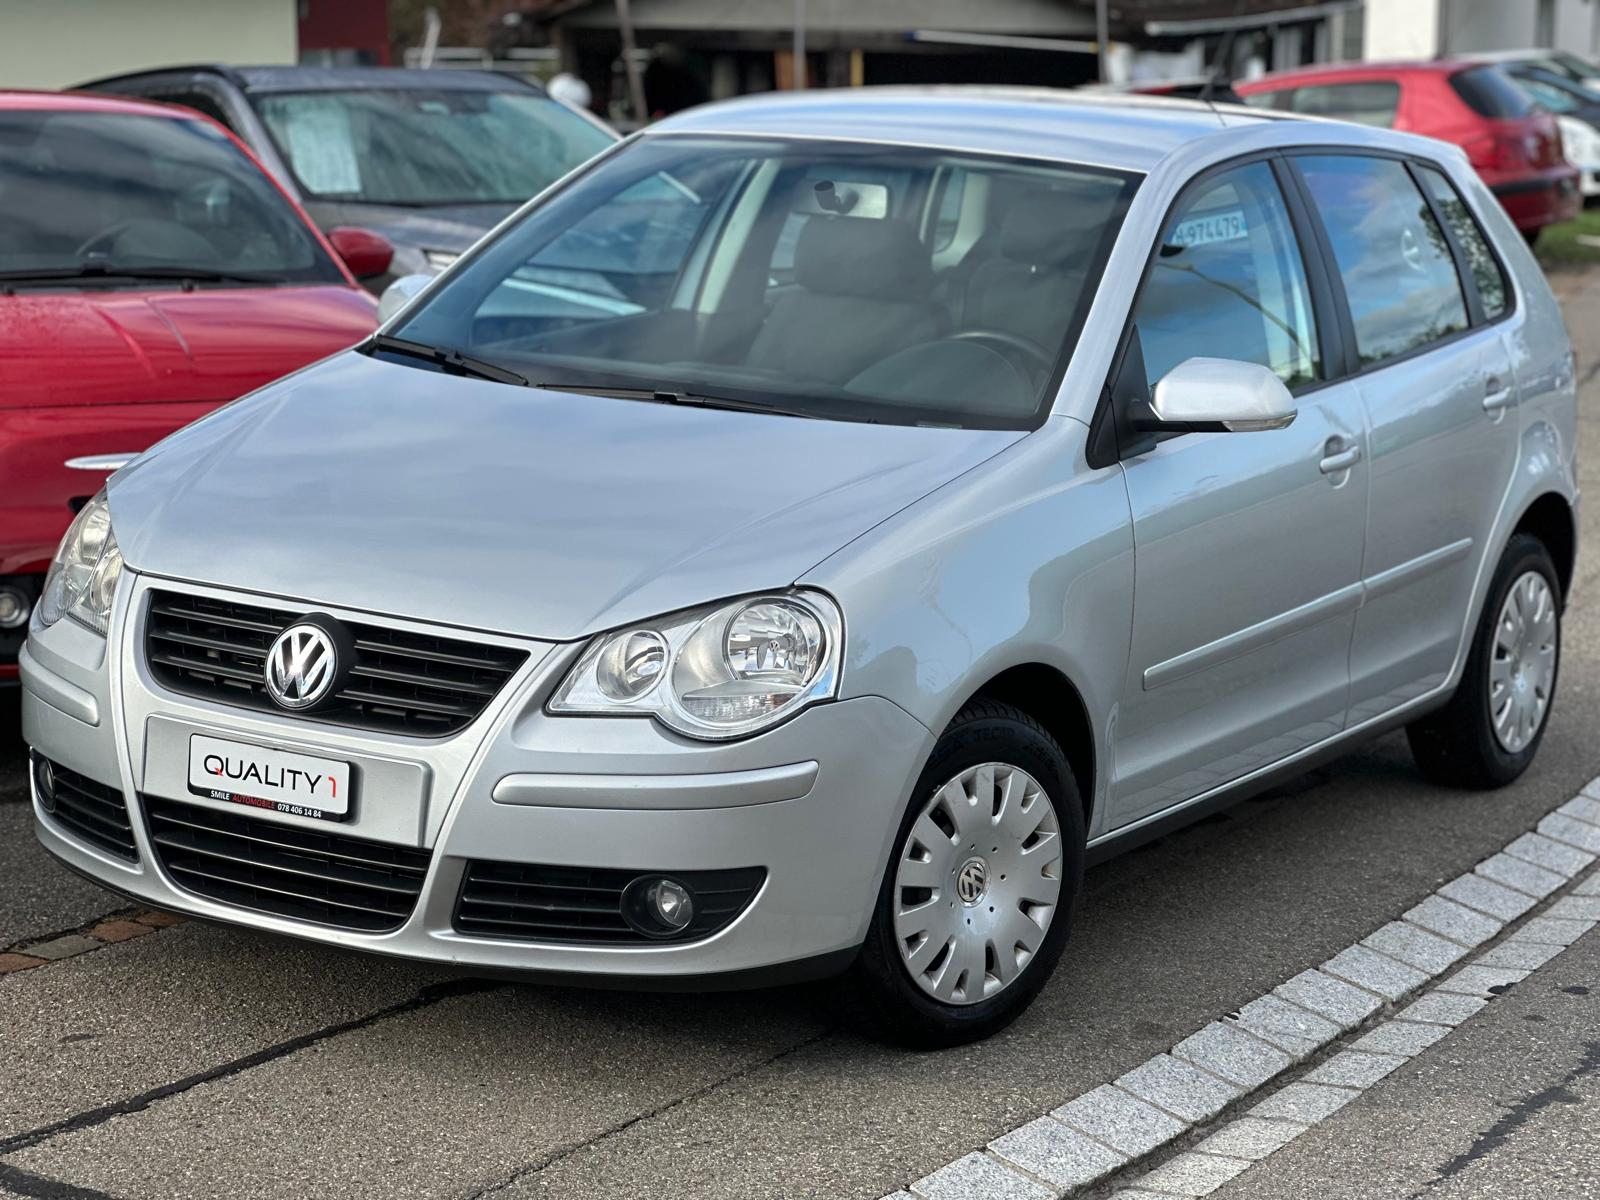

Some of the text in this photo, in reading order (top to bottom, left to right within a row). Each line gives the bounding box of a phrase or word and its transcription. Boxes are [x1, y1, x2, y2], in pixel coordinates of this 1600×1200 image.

[210, 790, 322, 818] SMILE AUTOMOBILE 078 406 14 84
